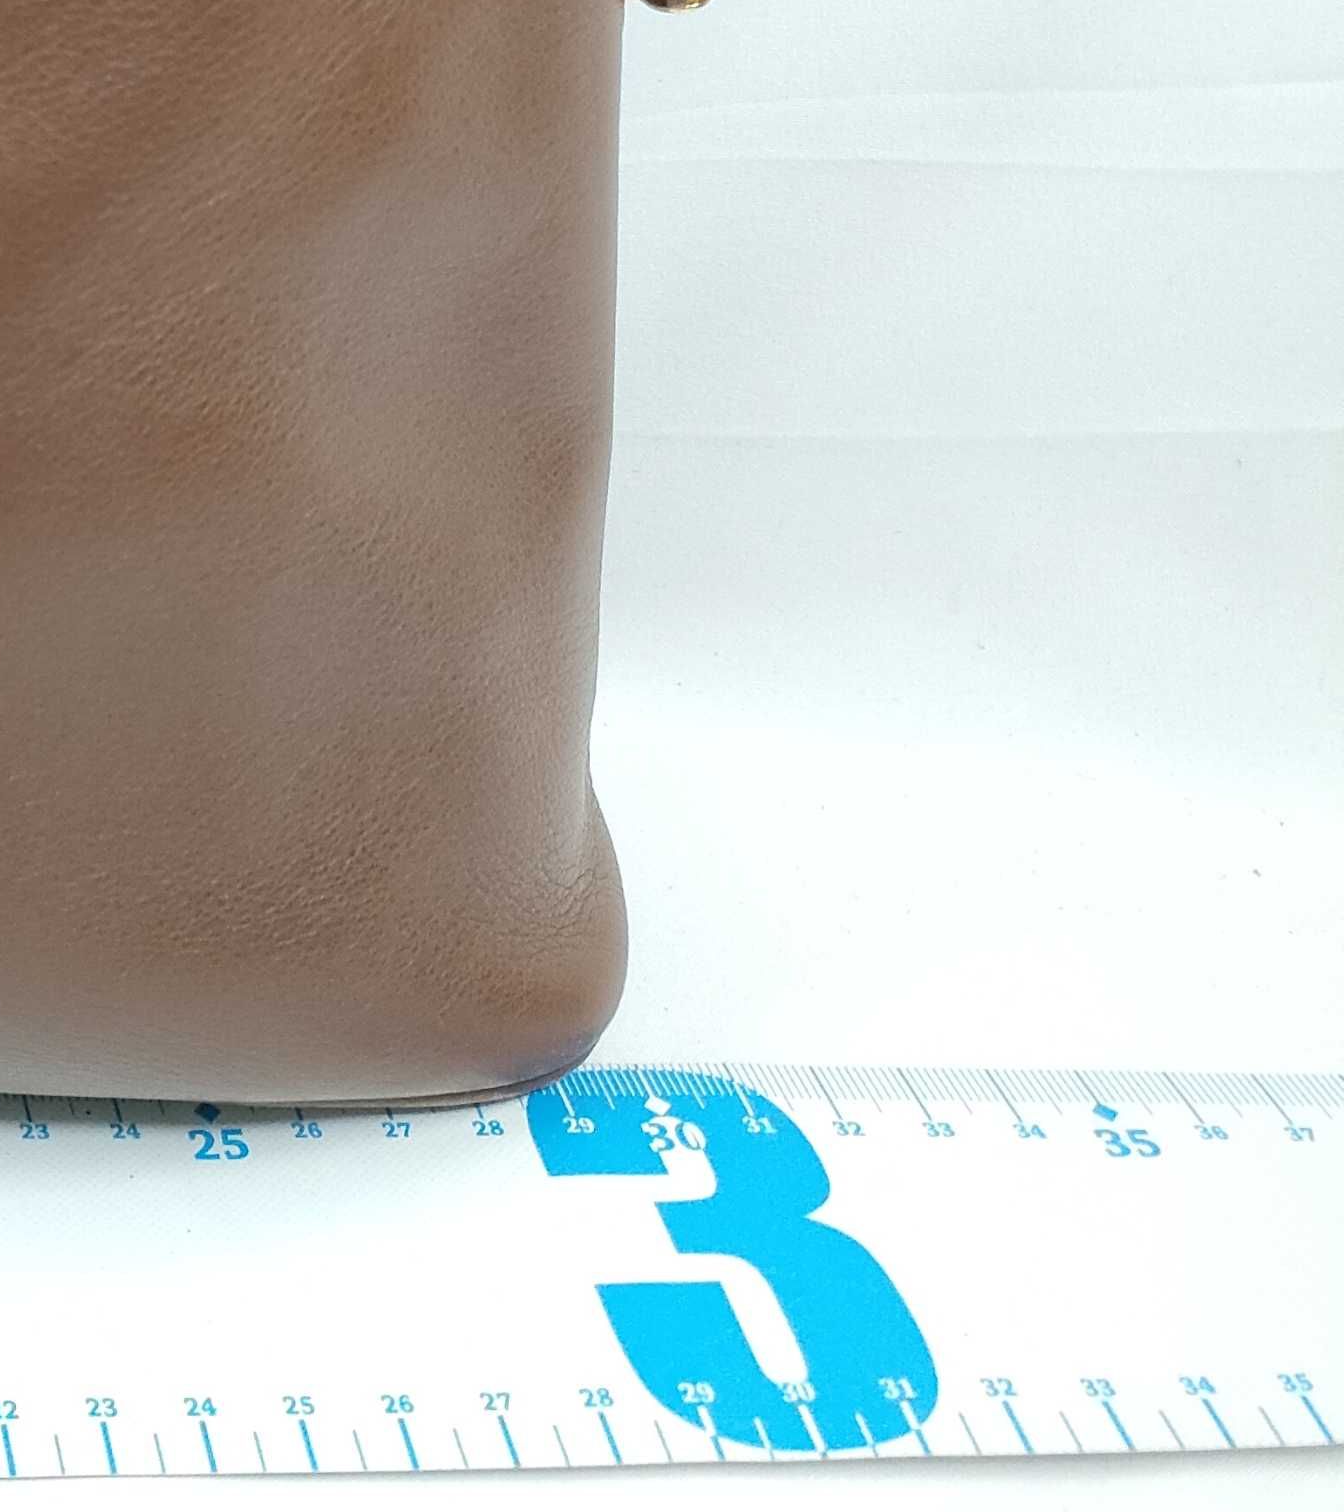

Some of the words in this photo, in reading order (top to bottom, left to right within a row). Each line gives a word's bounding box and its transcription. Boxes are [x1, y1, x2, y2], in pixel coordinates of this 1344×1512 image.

[20, 1124, 50, 1139] 23
[112, 1123, 140, 1139] 24
[188, 1129, 250, 1160] 25
[291, 1123, 322, 1138] 26
[382, 1122, 410, 1138] 27
[473, 1121, 504, 1137] 28
[563, 1116, 595, 1134] 29
[642, 1120, 706, 1153] 30
[743, 1116, 776, 1135] 31
[832, 1121, 865, 1137] 32
[922, 1122, 955, 1138] 33
[1013, 1123, 1047, 1140] 34
[1094, 1129, 1161, 1158] 35
[1284, 1125, 1316, 1142] 37
[526, 1068, 938, 1451] 3
[85, 1398, 118, 1418] 23
[183, 1398, 216, 1416] 24
[282, 1397, 315, 1415] 25
[381, 1396, 414, 1414] 26
[480, 1392, 511, 1412] 27
[579, 1389, 613, 1408] 28
[678, 1383, 714, 1404] 29
[781, 1383, 815, 1403] 30
[878, 1379, 914, 1399] 31
[980, 1378, 1017, 1397] 32
[1080, 1378, 1117, 1398] 33
[1178, 1377, 1215, 1396] 34
[1277, 1374, 1313, 1394] 35
